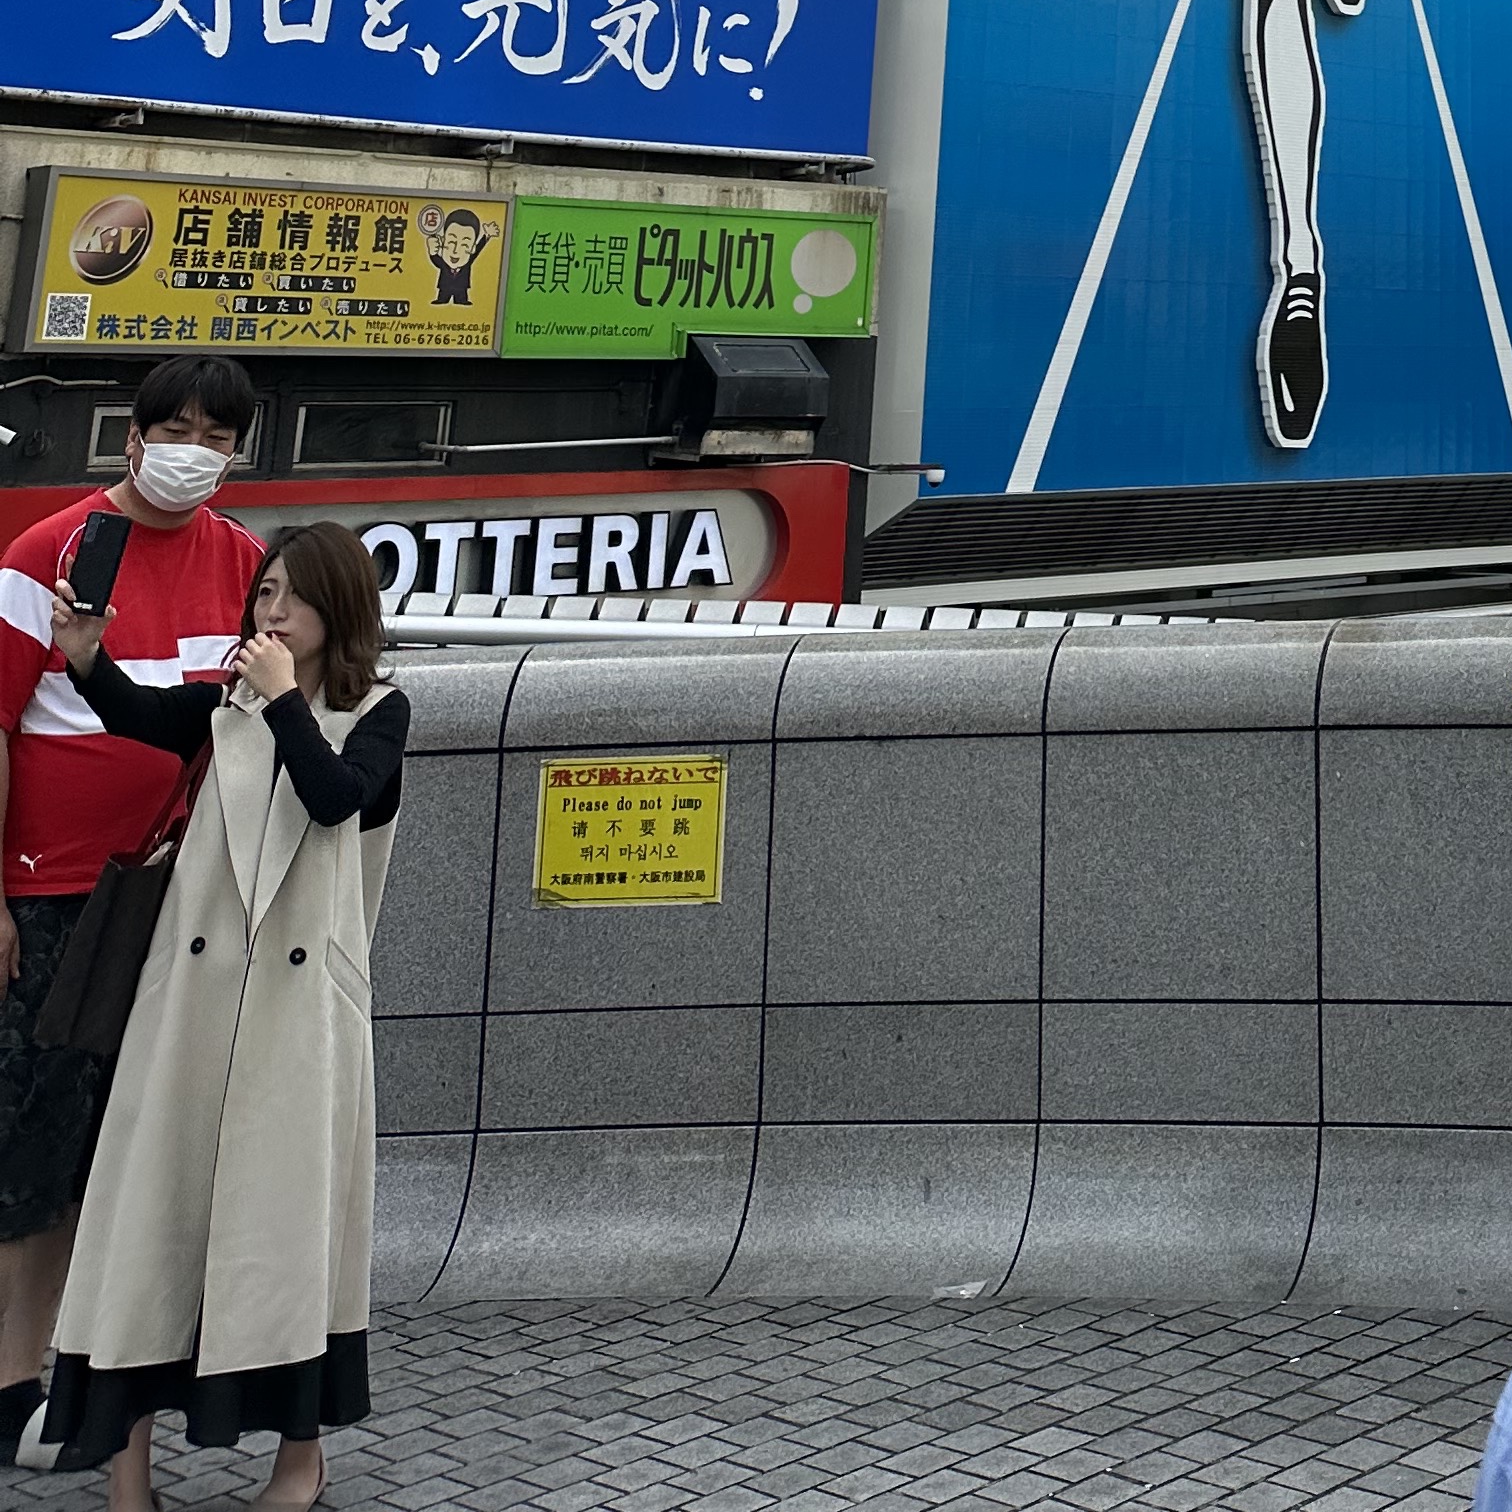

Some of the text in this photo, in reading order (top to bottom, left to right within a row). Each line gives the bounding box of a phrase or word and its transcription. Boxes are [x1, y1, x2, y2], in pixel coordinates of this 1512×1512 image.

[178, 188, 409, 215] KANSAI INVEST CORPORATION
[172, 206, 407, 255] 店舗情報館
[168, 249, 404, 274] 居抜き店舗総合プロデュース
[635, 224, 775, 310] ピタットハウス
[173, 272, 355, 291] 借りたい 買いたい
[96, 314, 356, 344] 株式会社 関西インベスト
[365, 319, 491, 333] http://www.k-invest.co.jp
[516, 322, 653, 338] http://www.pitat.com/
[365, 332, 489, 346] TEL 06-6766-2016
[360, 509, 733, 599] OTTERIA
[550, 766, 719, 787] 飛び跳ねないで
[563, 794, 702, 812] Please do not jump
[580, 843, 679, 863] 뛰지 마십시오
